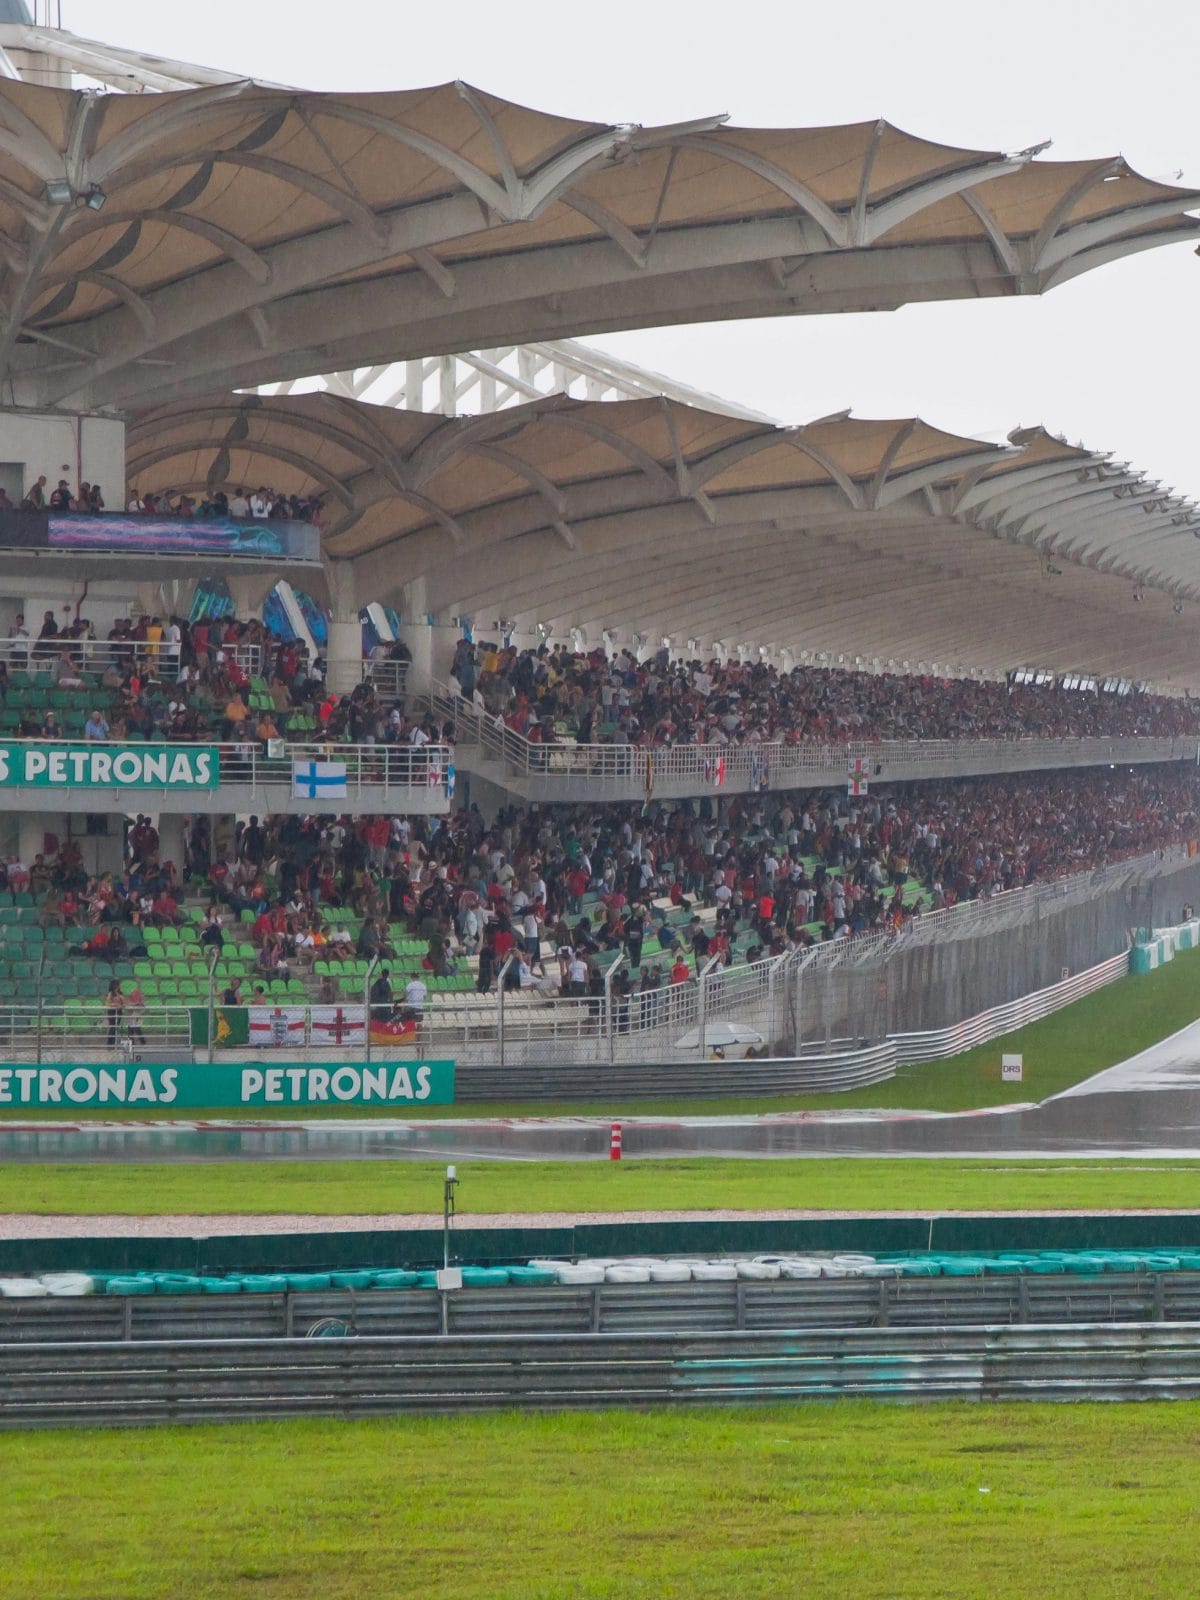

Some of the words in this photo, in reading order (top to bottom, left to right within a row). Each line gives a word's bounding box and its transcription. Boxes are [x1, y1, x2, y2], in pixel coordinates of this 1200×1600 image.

[25, 751, 210, 784] PETRONAS
[240, 1066, 431, 1102] PETRONAS
[1003, 1065, 1021, 1074] DRS
